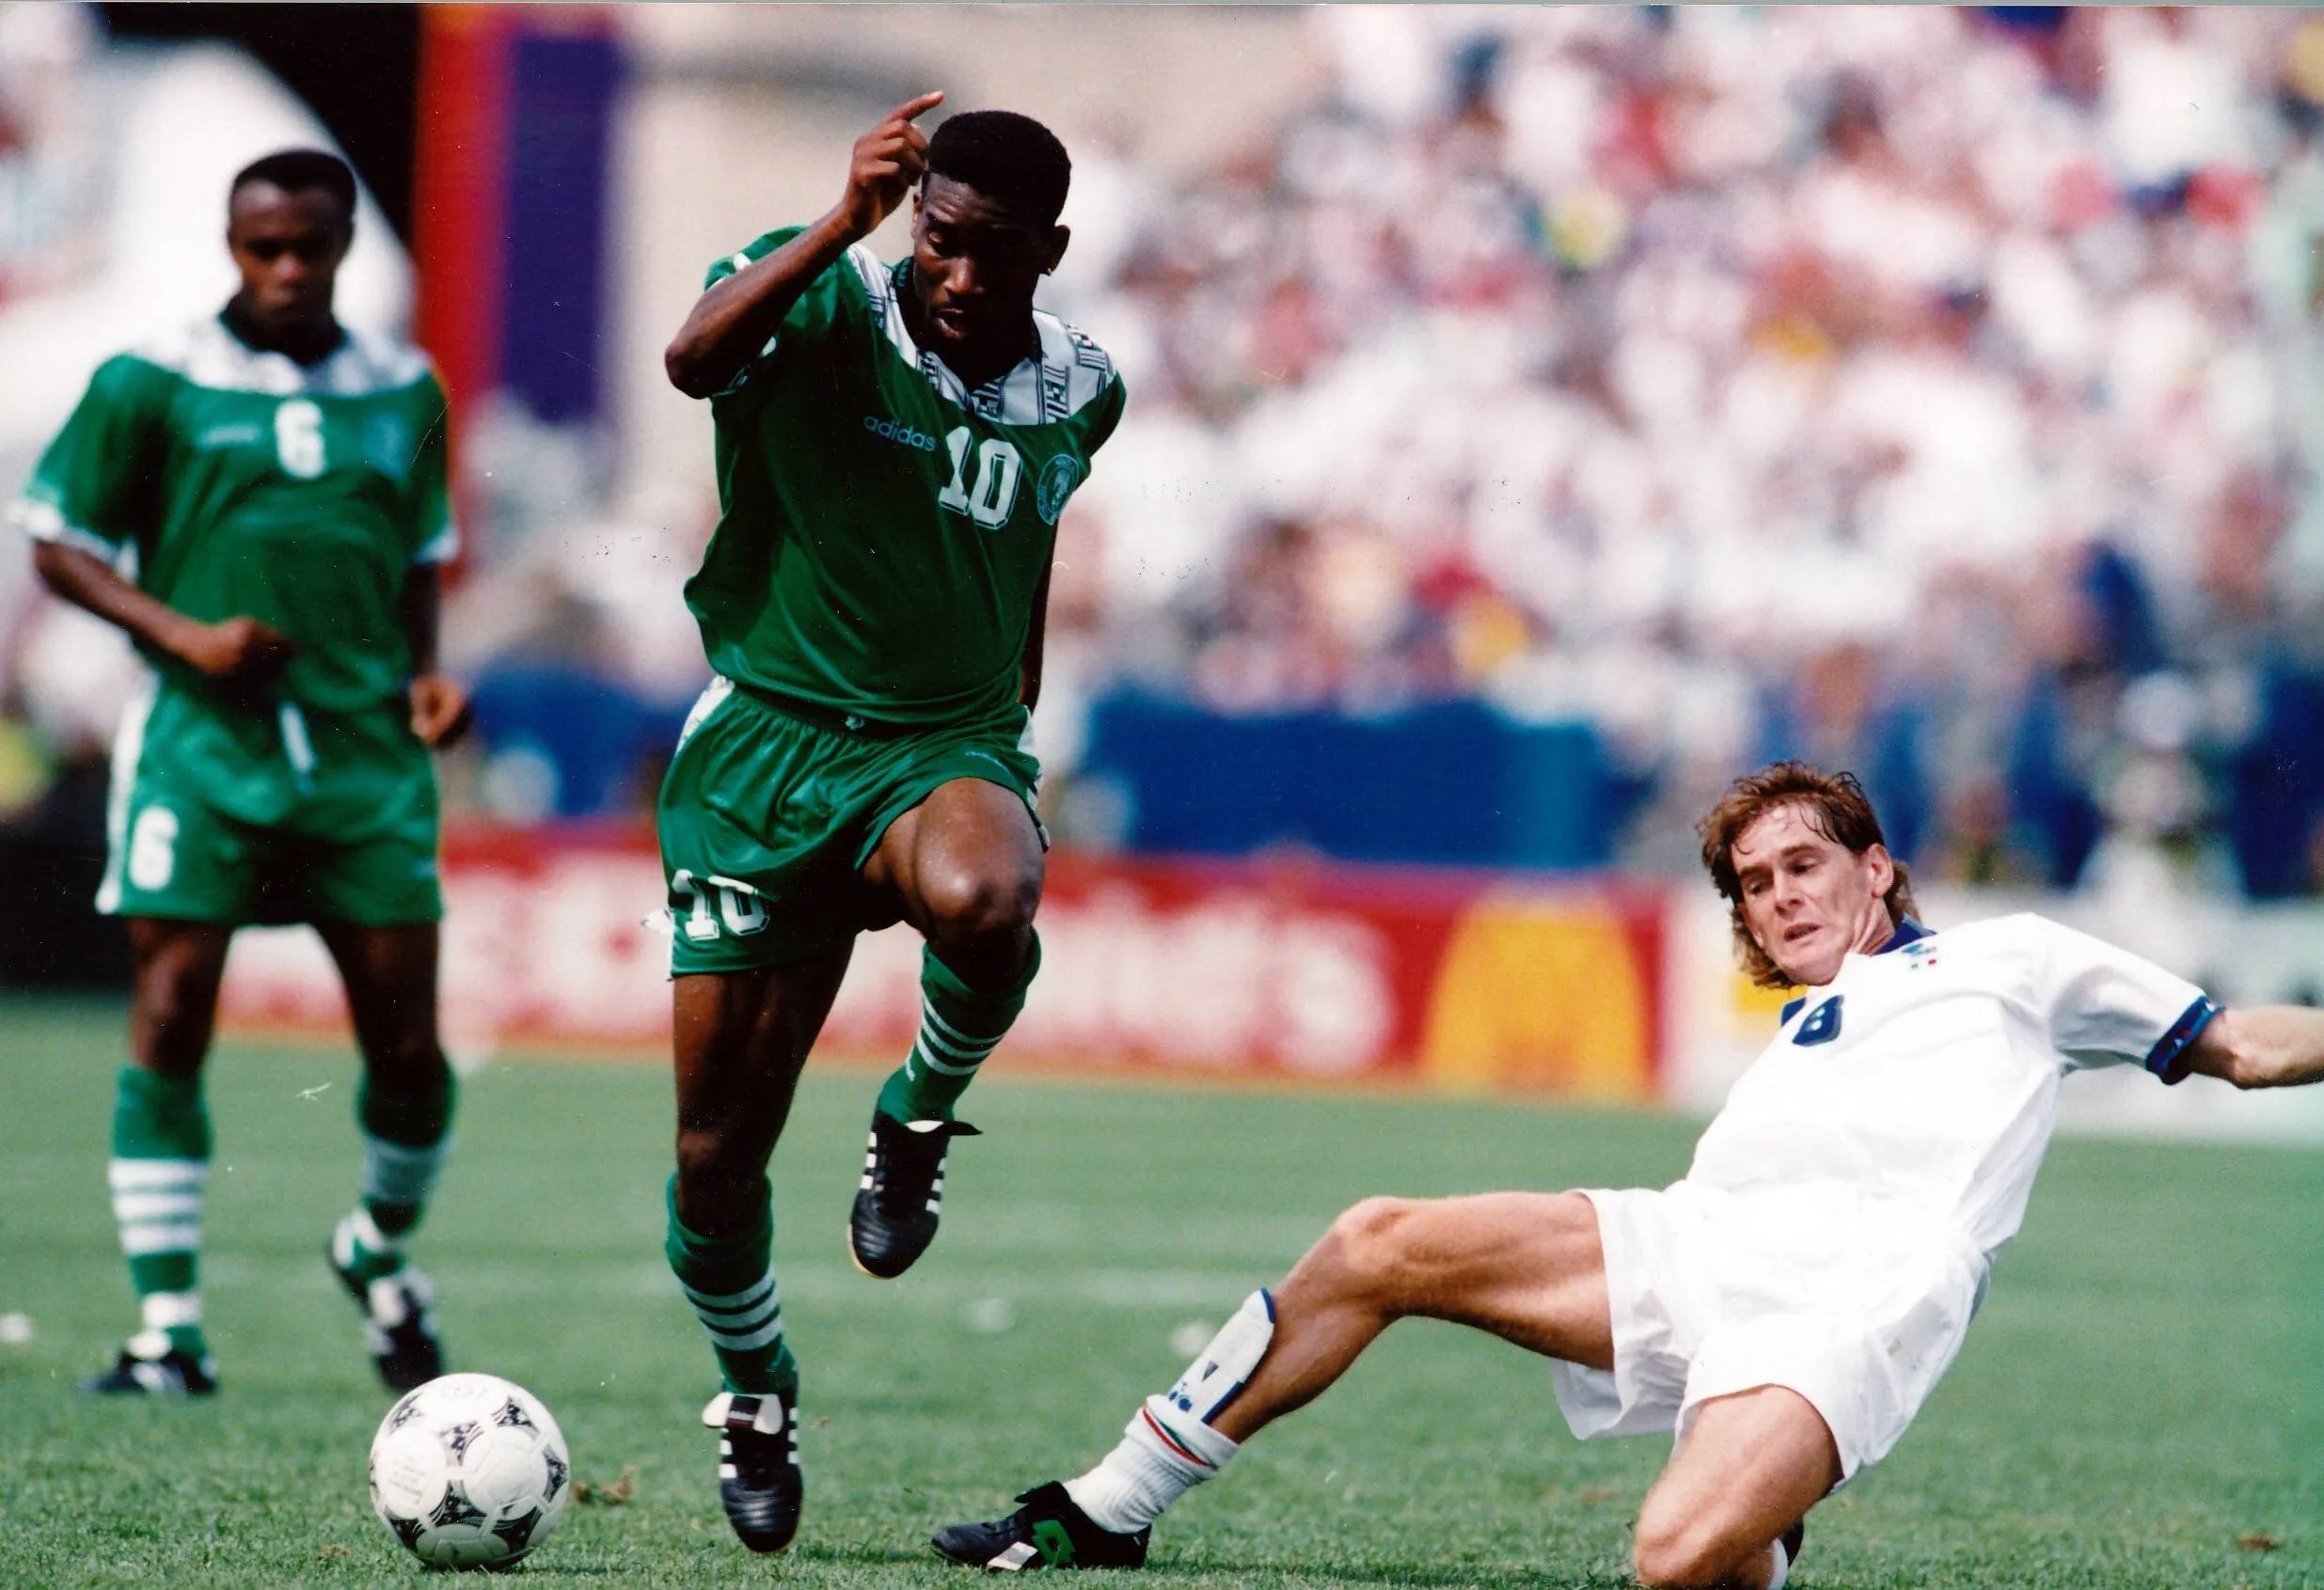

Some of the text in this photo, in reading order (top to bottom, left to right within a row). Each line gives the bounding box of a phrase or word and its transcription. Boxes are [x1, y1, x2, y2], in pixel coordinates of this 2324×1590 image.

[275, 399, 325, 480] 6
[862, 415, 937, 452] adidas
[939, 425, 1023, 529] 10
[129, 805, 179, 890] 6
[672, 869, 770, 940] 10
